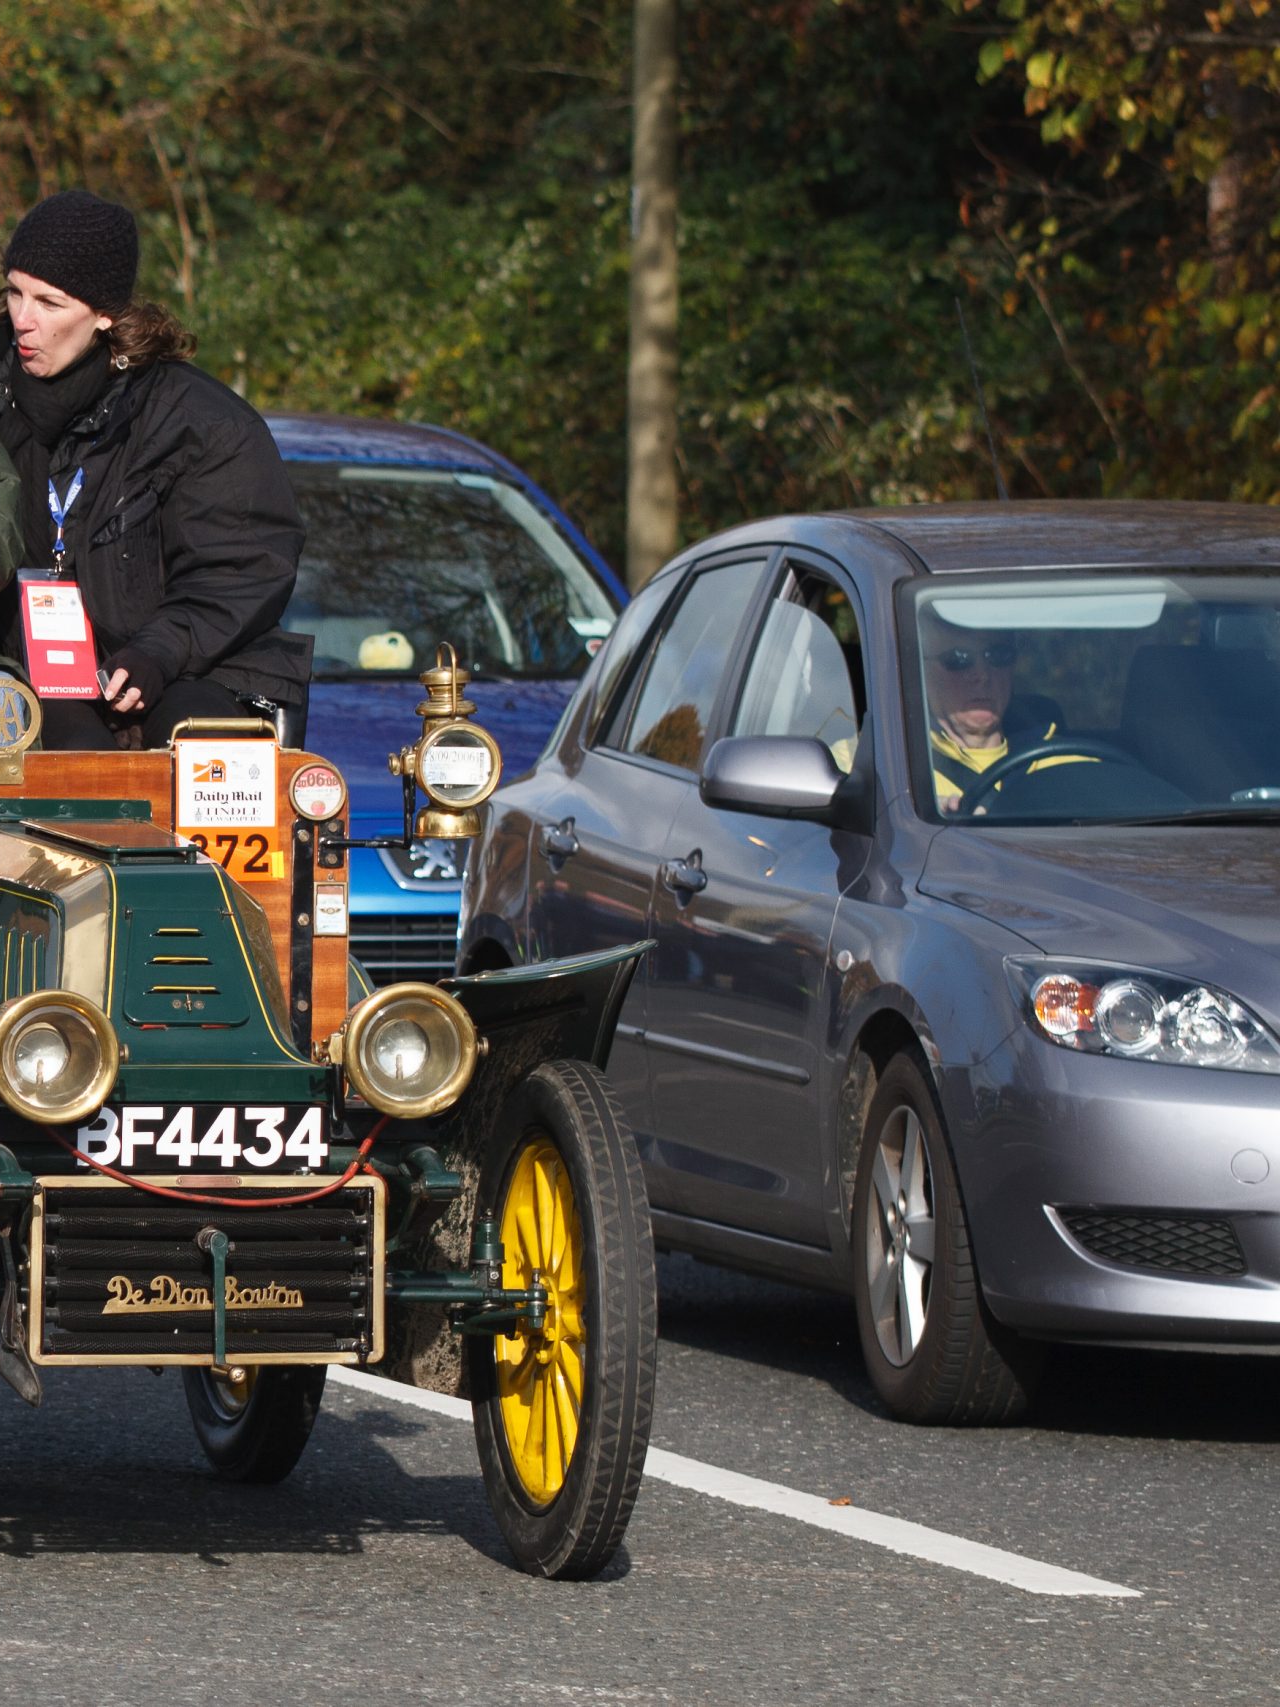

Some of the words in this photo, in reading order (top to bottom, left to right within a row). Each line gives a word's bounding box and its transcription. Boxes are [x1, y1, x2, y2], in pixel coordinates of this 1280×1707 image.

[38, 685, 94, 695] PARTICIPANT
[307, 773, 325, 787] 06
[194, 790, 229, 804] Daily
[232, 791, 262, 801] Mail
[77, 1106, 328, 1168] BF4434
[107, 1275, 145, 1304] De
[149, 1275, 213, 1305] Dion
[224, 1275, 304, 1305] Bouton
